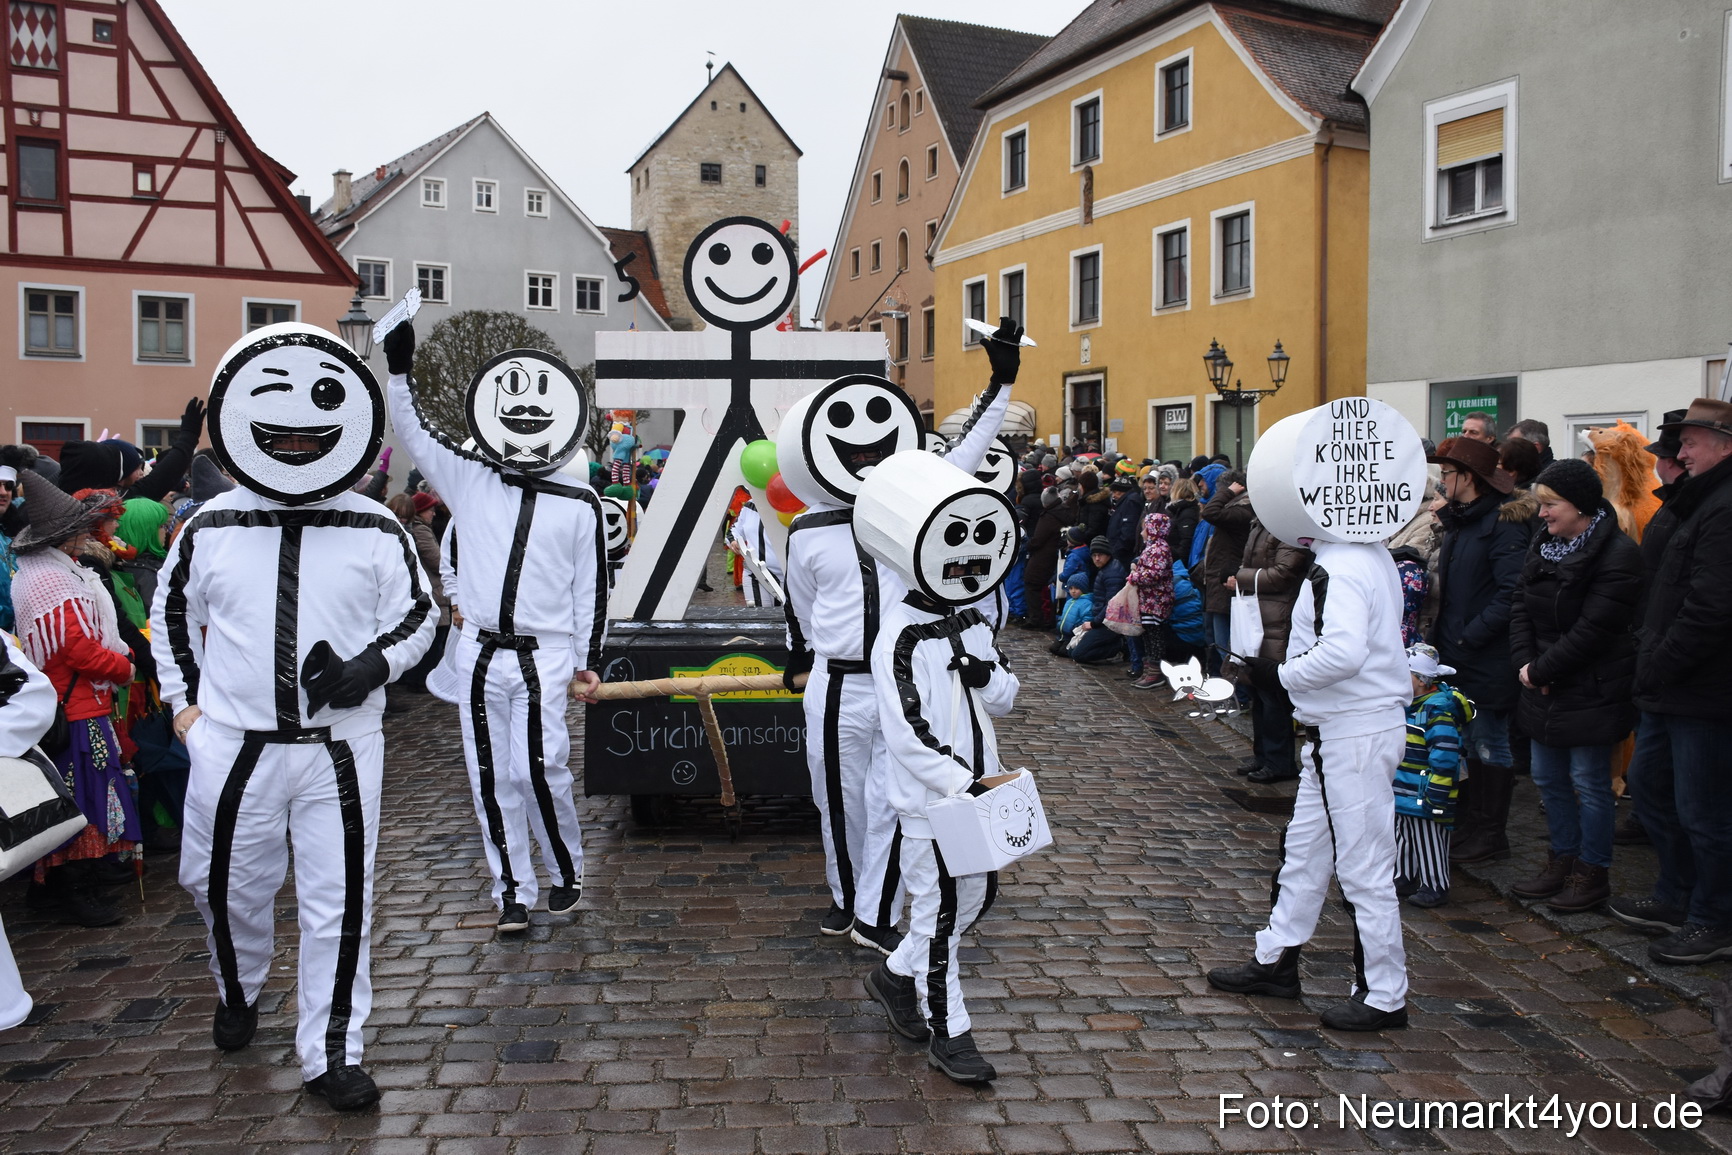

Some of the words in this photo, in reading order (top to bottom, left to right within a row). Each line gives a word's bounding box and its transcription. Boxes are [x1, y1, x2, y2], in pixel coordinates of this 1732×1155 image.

[1331, 398, 1369, 419] UND
[1447, 400, 1456, 409] ZU
[1458, 398, 1497, 408] VERMIETEN
[1166, 410, 1186, 422] BW
[1333, 420, 1379, 440] HIER
[1315, 440, 1395, 463] KÖNNTE
[1336, 463, 1380, 483] IHRE
[1299, 482, 1411, 506] WERBUNNG
[1321, 504, 1405, 528] STEHEN.
[720, 663, 737, 674] mir
[606, 710, 807, 757] Strichanschg
